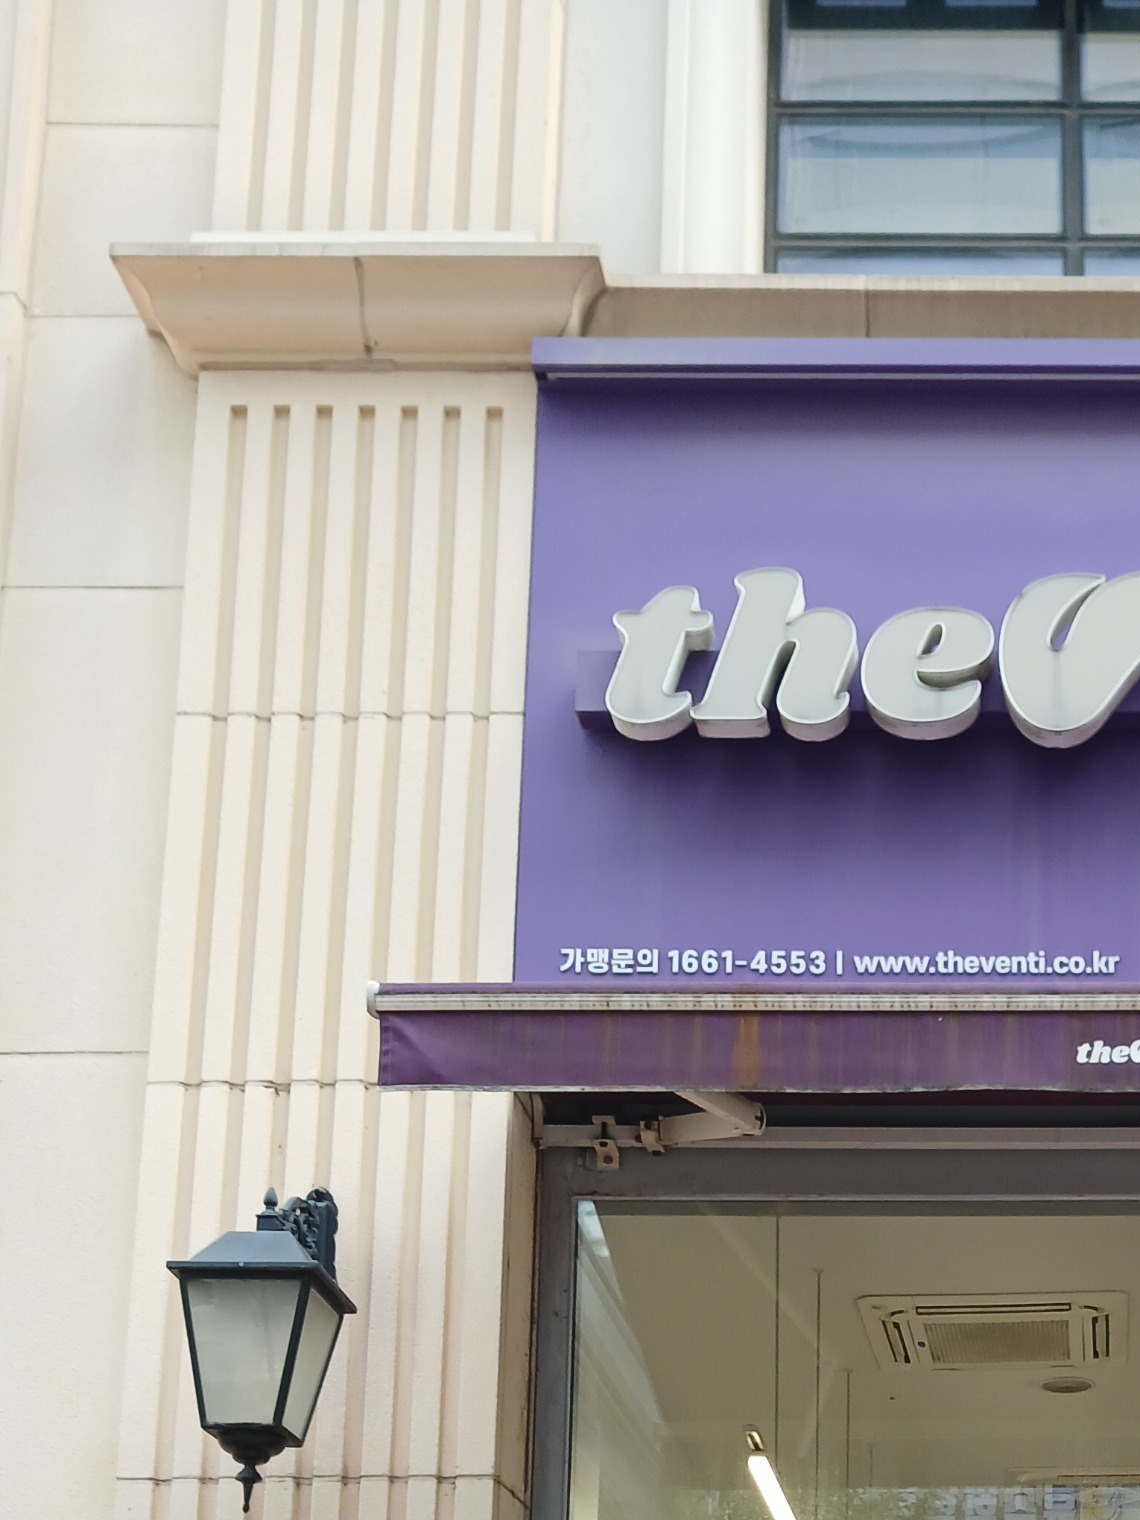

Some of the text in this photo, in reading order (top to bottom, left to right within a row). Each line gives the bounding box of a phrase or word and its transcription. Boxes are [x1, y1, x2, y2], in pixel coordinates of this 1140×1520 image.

[559, 947, 1121, 976] 가맹문의 1661-4553 www.theventi.co.kr
